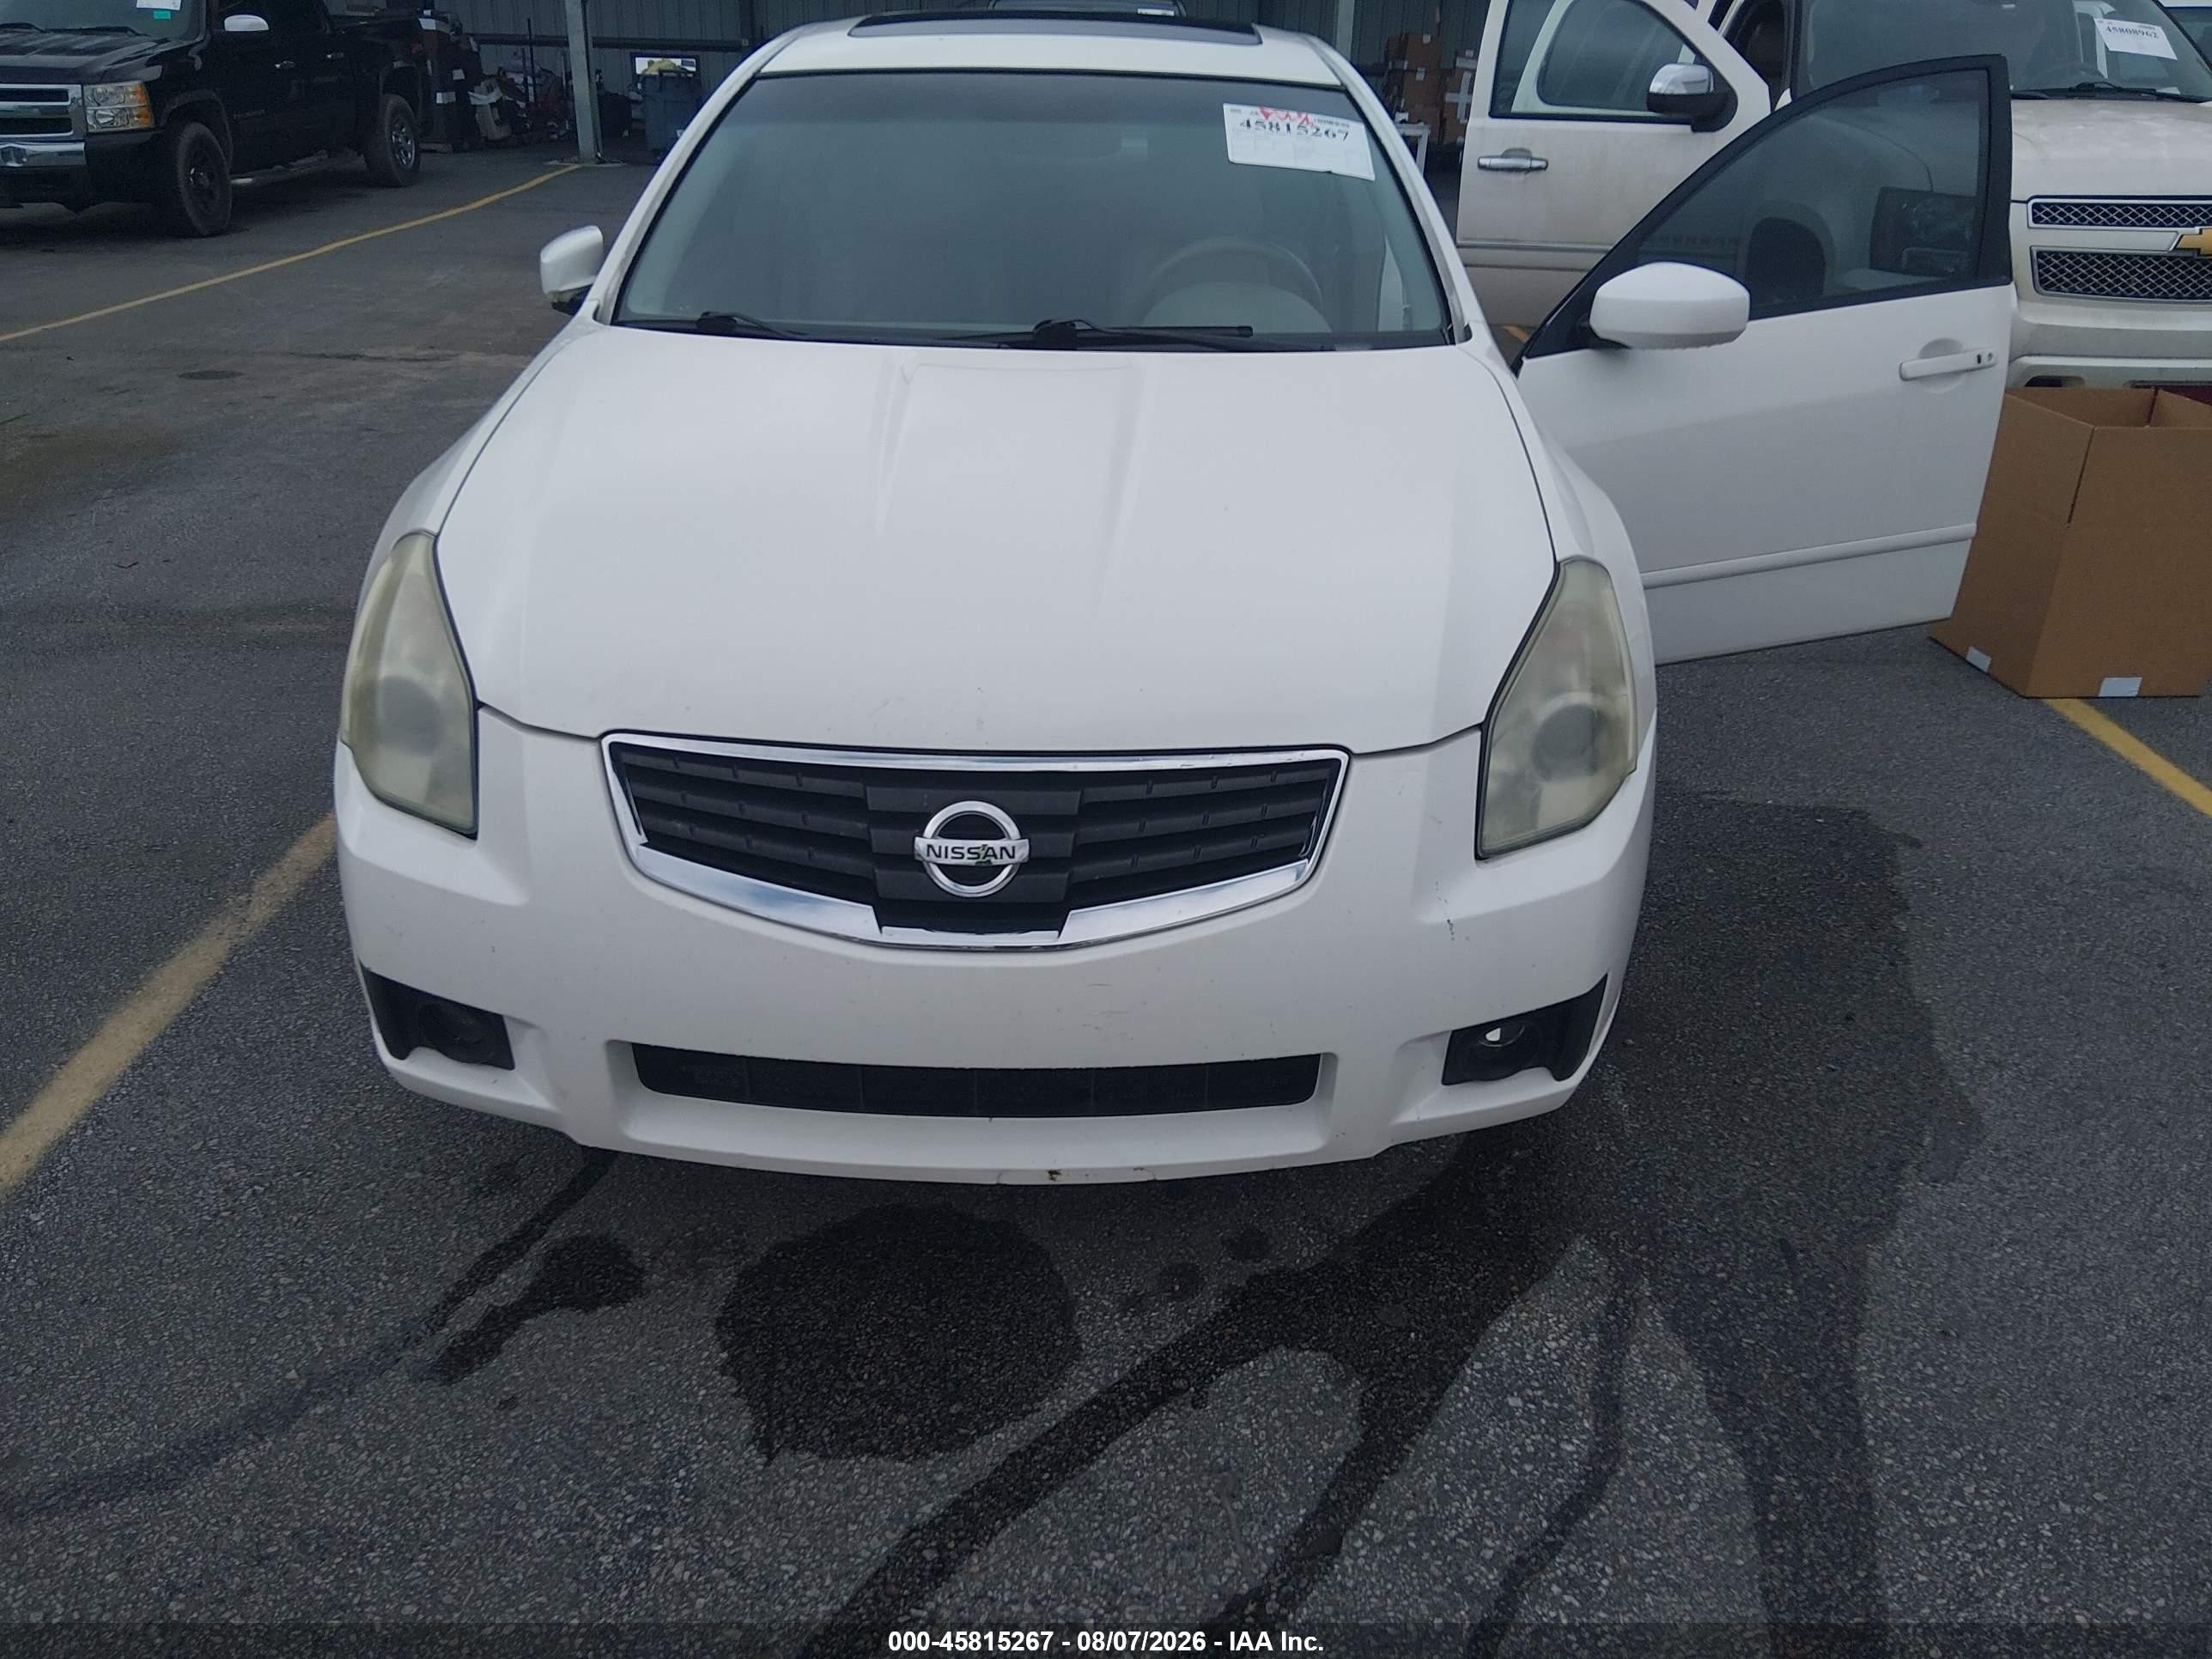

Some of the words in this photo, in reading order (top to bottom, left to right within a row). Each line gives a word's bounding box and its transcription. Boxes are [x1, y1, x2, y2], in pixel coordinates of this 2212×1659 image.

[2106, 26, 2159, 39] 45808962
[1241, 118, 1349, 141] 45815267
[927, 843, 1016, 860] NISSAN
